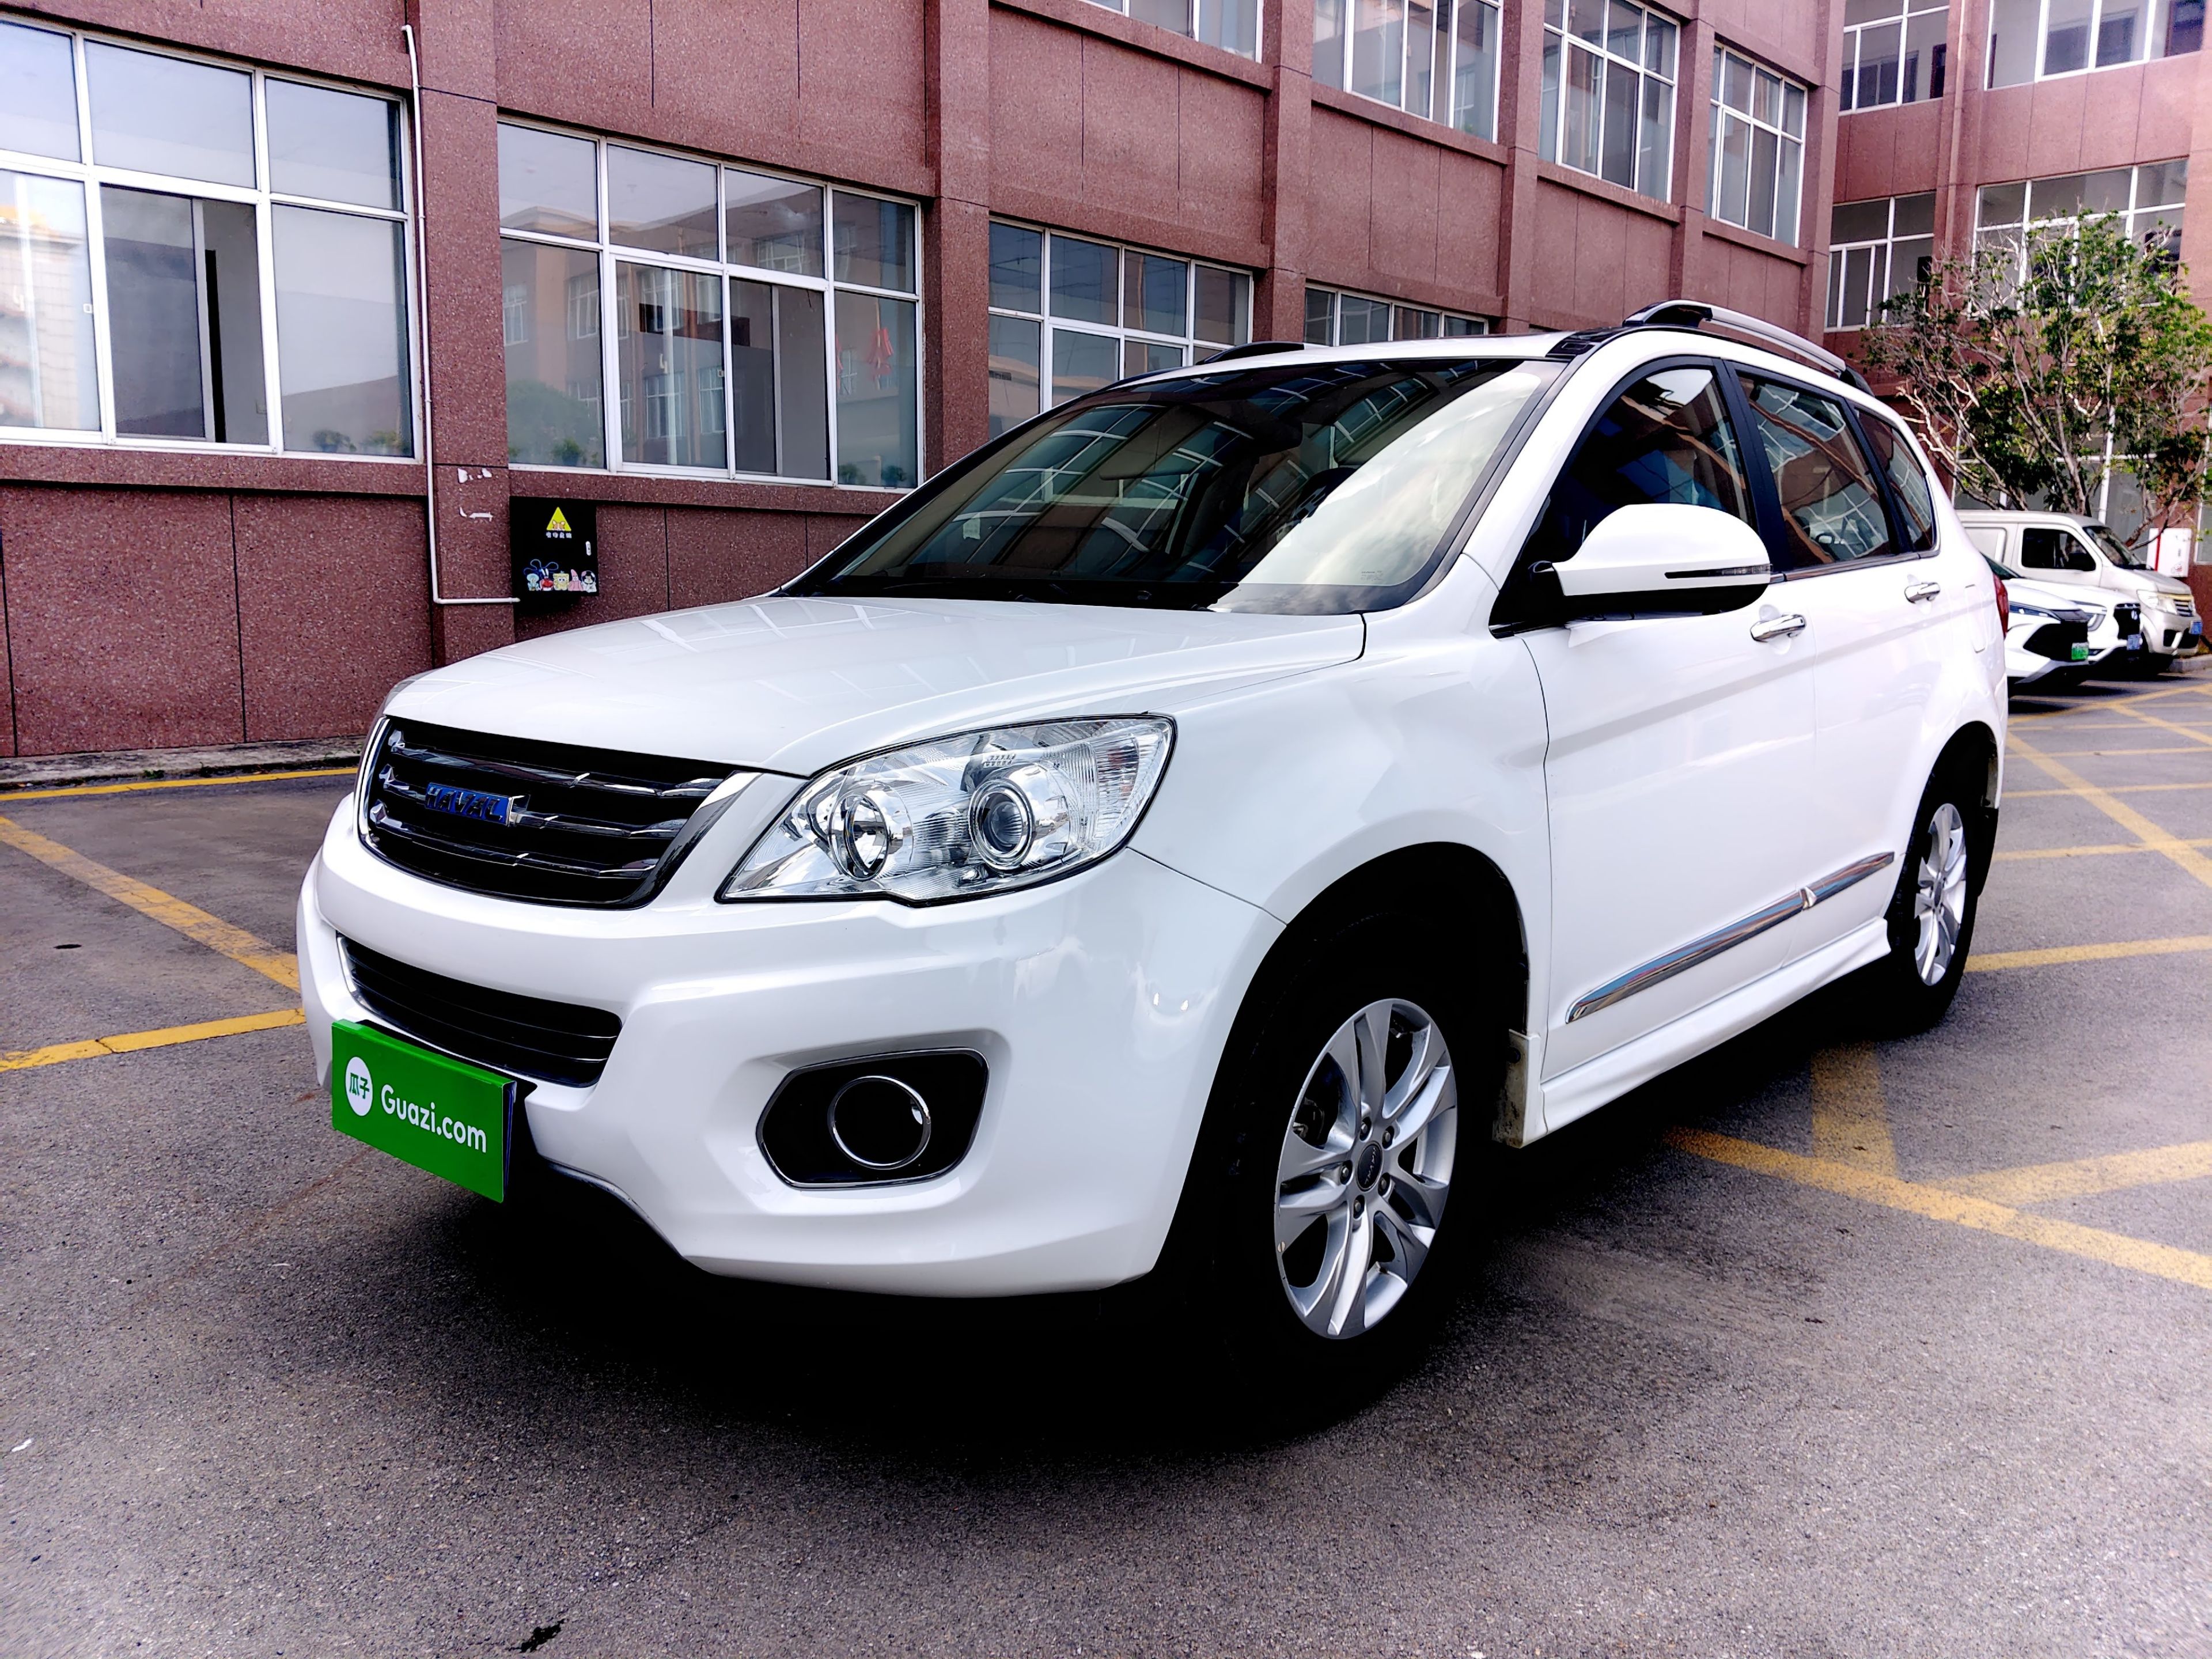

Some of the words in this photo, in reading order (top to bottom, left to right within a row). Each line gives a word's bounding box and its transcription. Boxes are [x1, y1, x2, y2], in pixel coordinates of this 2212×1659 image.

[426, 786, 503, 821] HAVAL
[349, 1072, 370, 1100] 瓜子
[381, 1084, 487, 1153] Guazi.com
